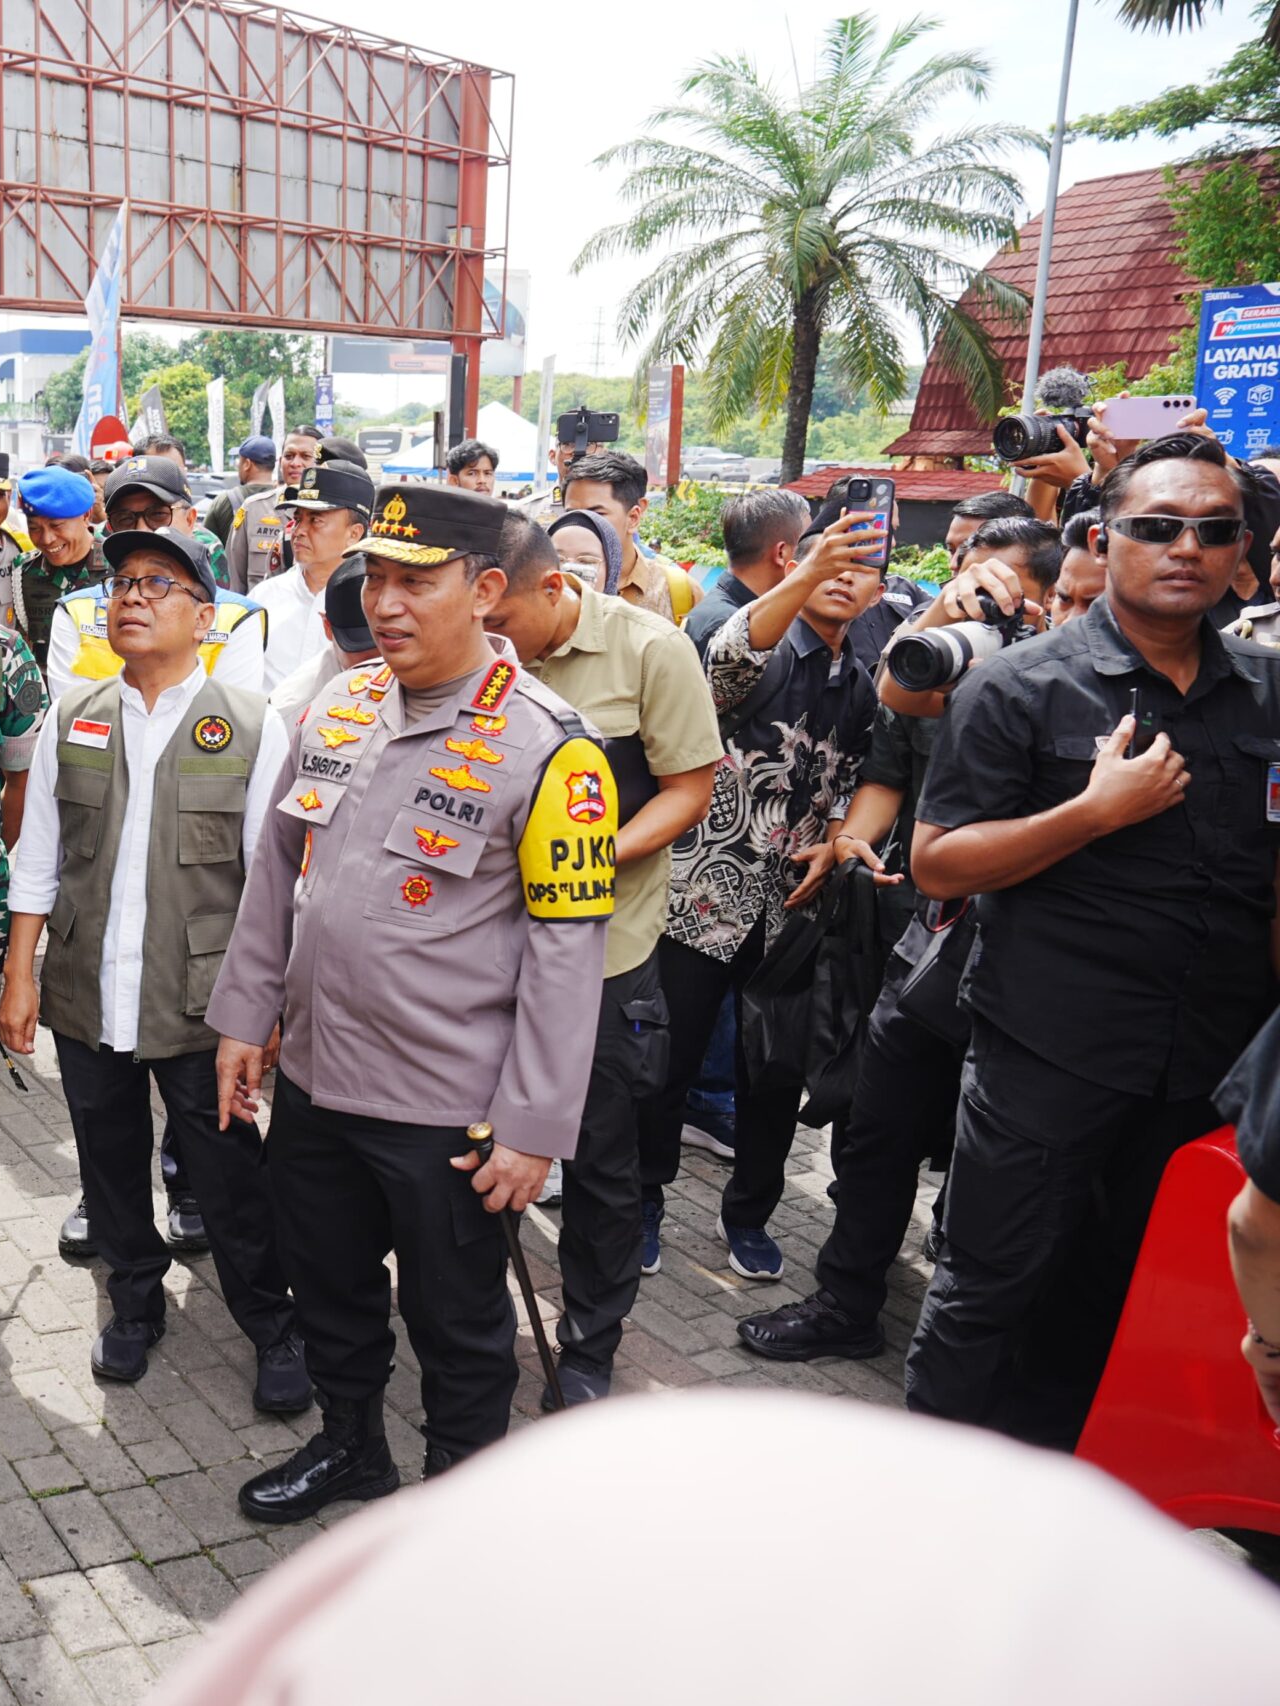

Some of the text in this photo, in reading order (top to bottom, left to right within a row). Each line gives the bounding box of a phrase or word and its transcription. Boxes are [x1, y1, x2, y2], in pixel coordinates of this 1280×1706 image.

[1213, 361, 1279, 380] GRATIS
[414, 786, 485, 826] POLRI
[528, 881, 559, 904] OPS
